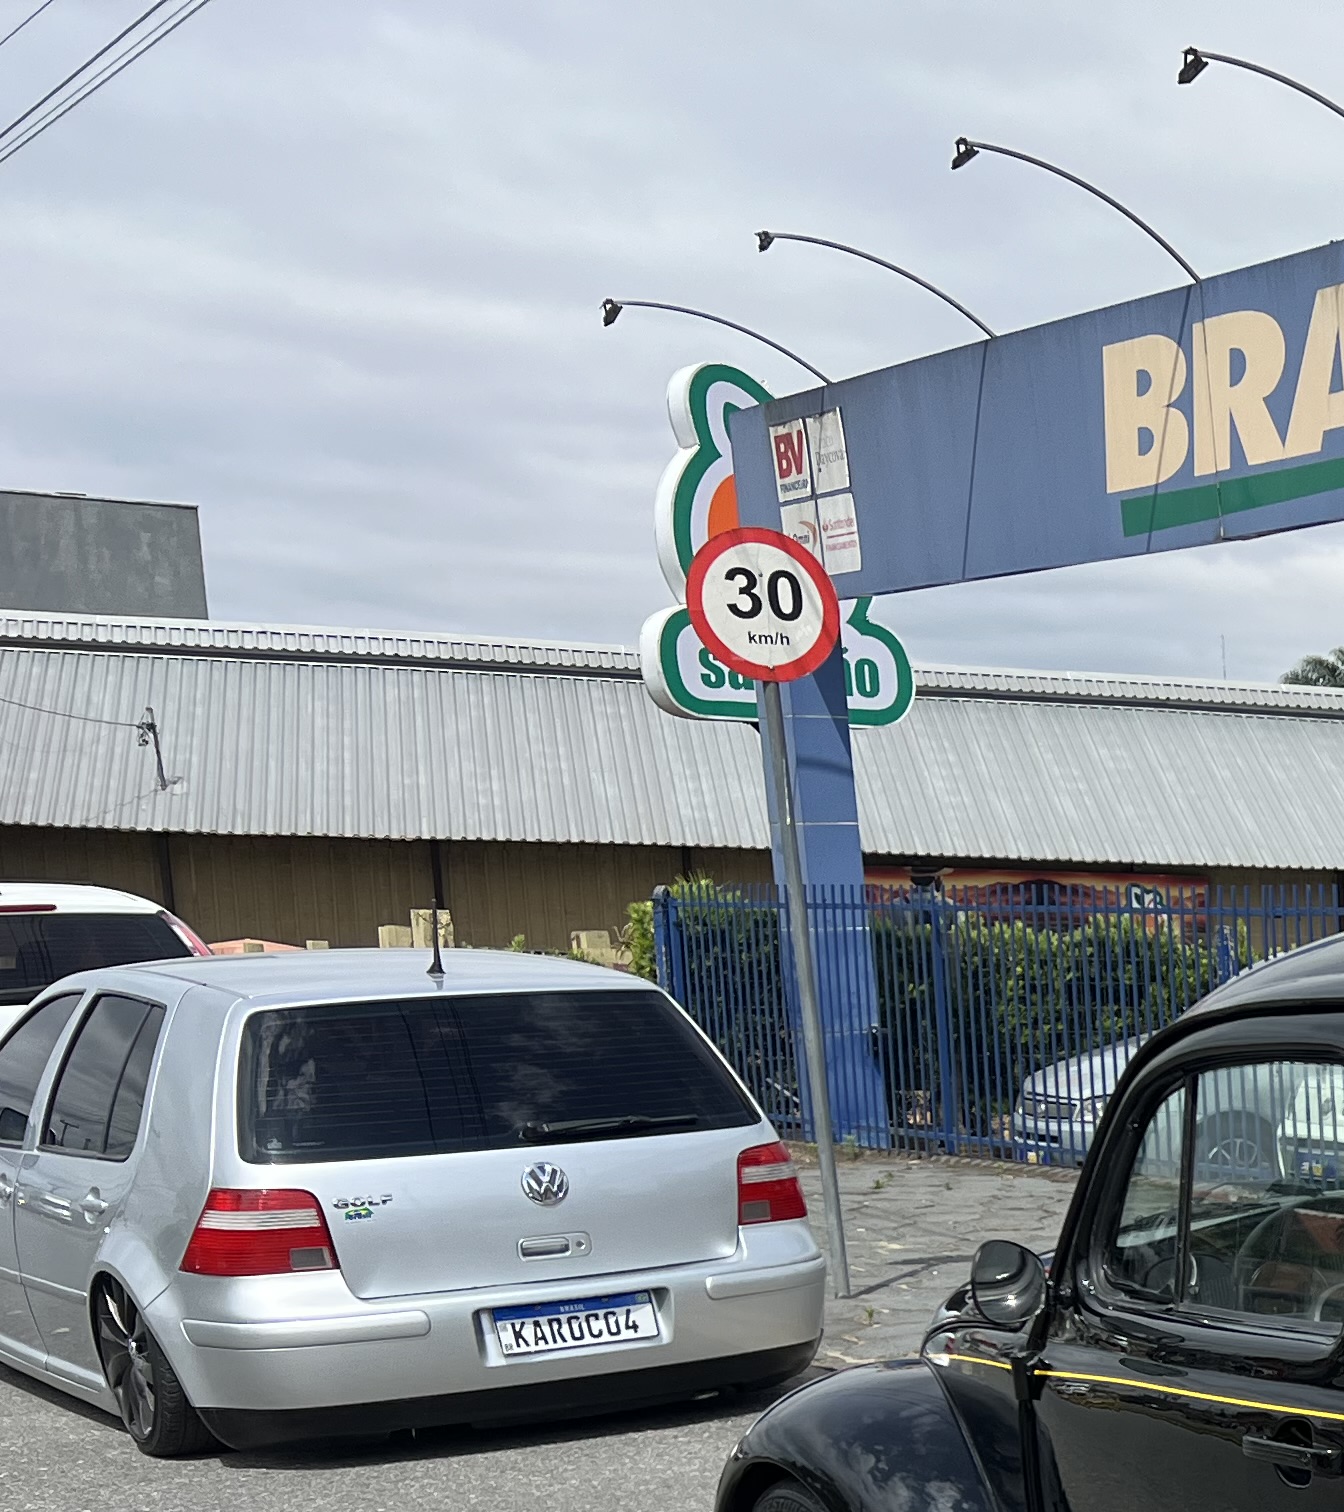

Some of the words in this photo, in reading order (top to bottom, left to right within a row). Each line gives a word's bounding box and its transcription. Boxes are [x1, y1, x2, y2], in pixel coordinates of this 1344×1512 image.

[774, 429, 804, 480] BV
[724, 566, 803, 622] 30
[747, 631, 791, 646] km/h
[332, 1194, 394, 1209] GOLF
